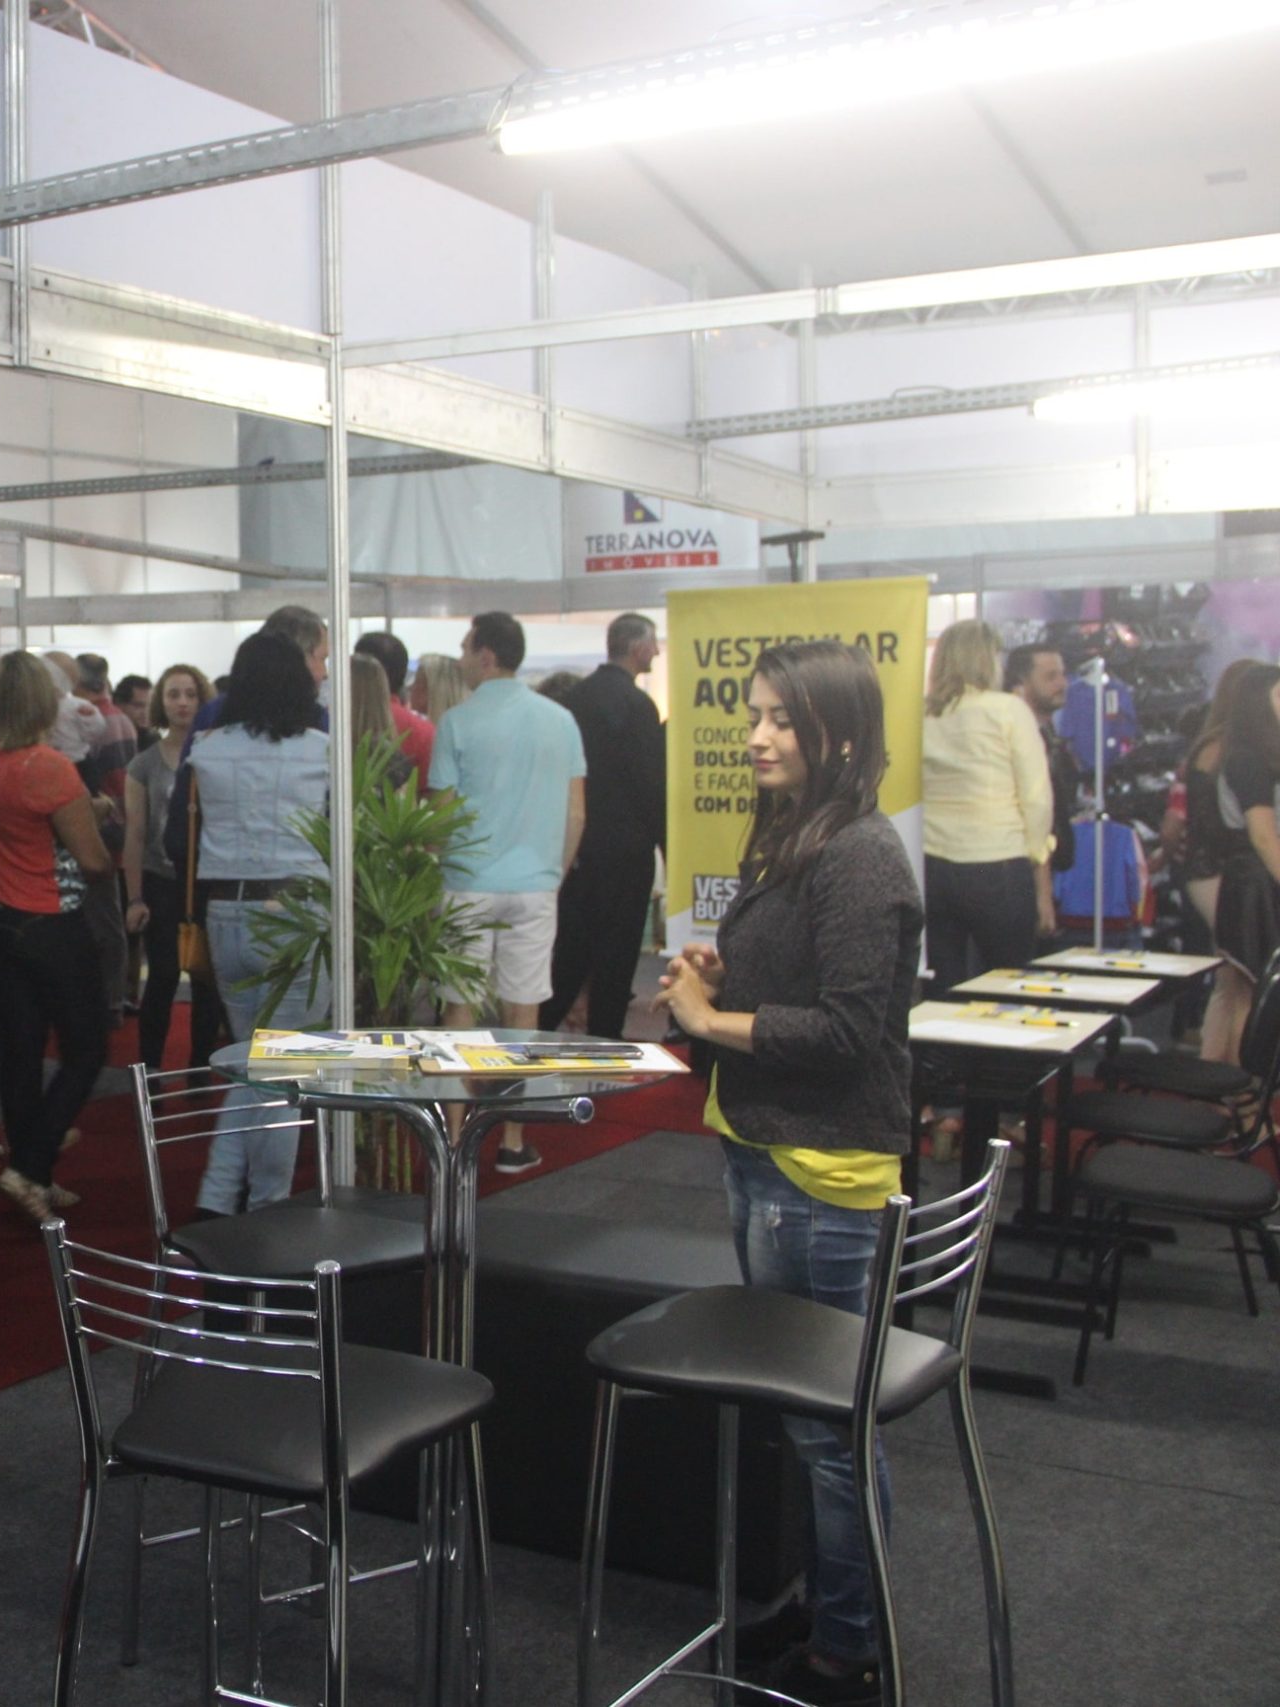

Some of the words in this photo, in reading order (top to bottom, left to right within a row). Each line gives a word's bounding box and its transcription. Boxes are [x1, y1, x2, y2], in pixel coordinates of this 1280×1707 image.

[585, 529, 717, 554] TERRANOVA
[694, 751, 752, 768] BOLSA
[708, 773, 750, 794] FAÇA
[694, 797, 731, 813] COM
[695, 876, 740, 900] VES
